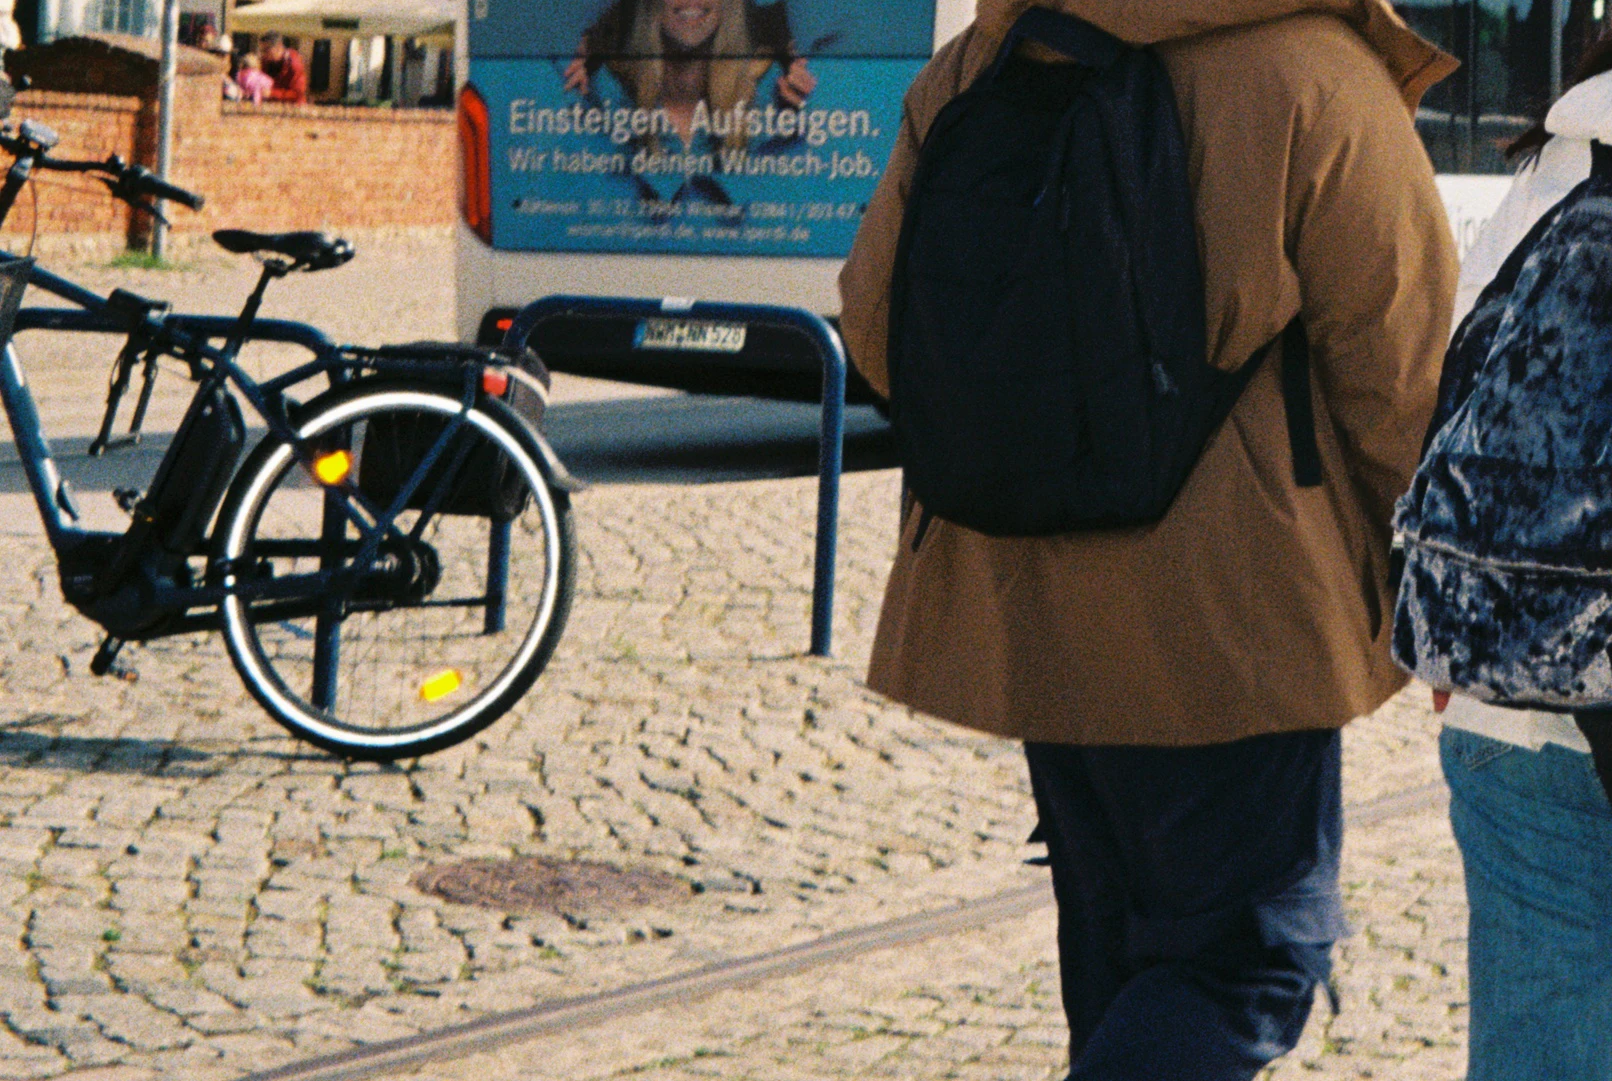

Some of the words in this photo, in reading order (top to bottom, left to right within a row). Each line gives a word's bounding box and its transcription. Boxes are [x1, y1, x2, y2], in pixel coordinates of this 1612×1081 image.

[509, 99, 678, 144] Einsteigen.
[689, 100, 881, 146] Aufsteigen.
[508, 146, 546, 172] Wir
[552, 147, 625, 174] haben
[631, 148, 713, 175] deinen
[720, 149, 880, 180] Wunsch-Job.
